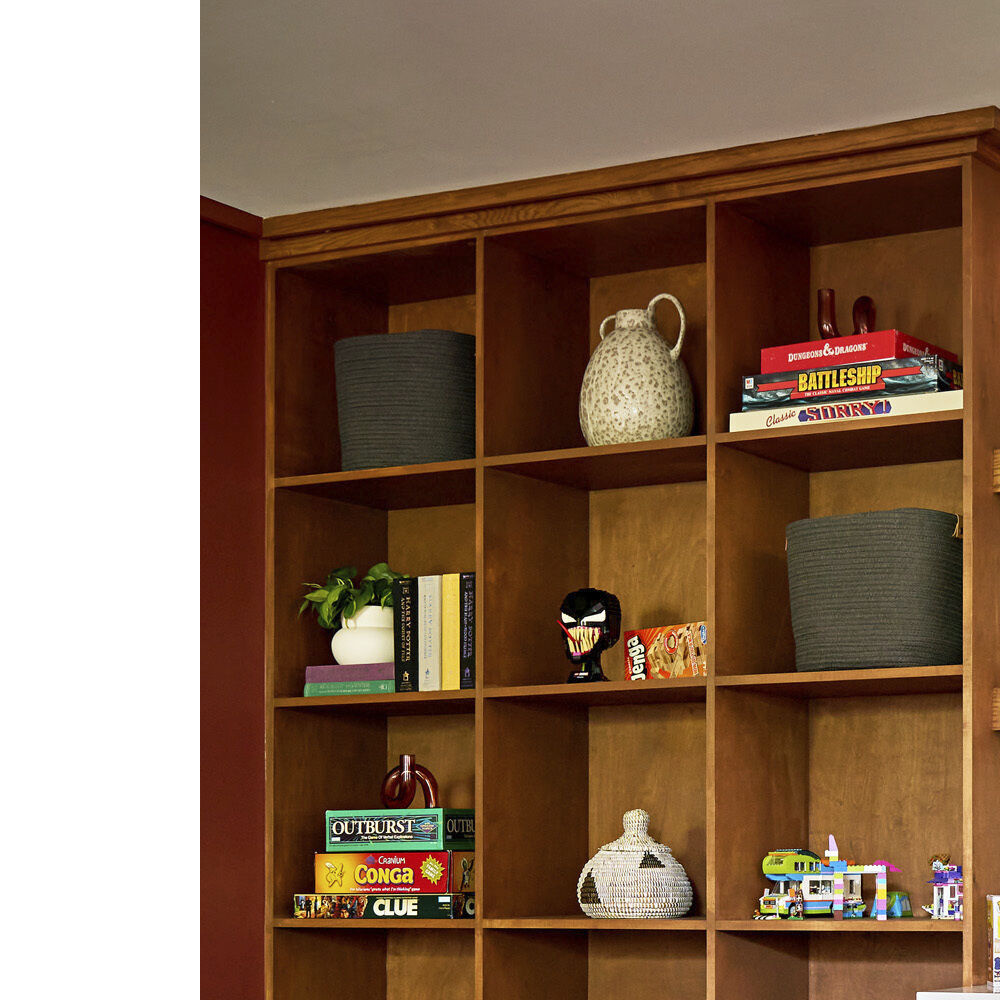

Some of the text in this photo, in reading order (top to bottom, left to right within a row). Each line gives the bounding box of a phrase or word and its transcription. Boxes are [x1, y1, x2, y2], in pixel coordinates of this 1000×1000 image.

[788, 343, 867, 362] DUNGEONS & DRAGONS
[798, 365, 882, 391] BATTLESHIP
[766, 400, 889, 427] Classic SORRY!
[627, 635, 646, 680] Jenga
[332, 819, 416, 834] OUTBURST
[373, 898, 418, 916] CLUE
